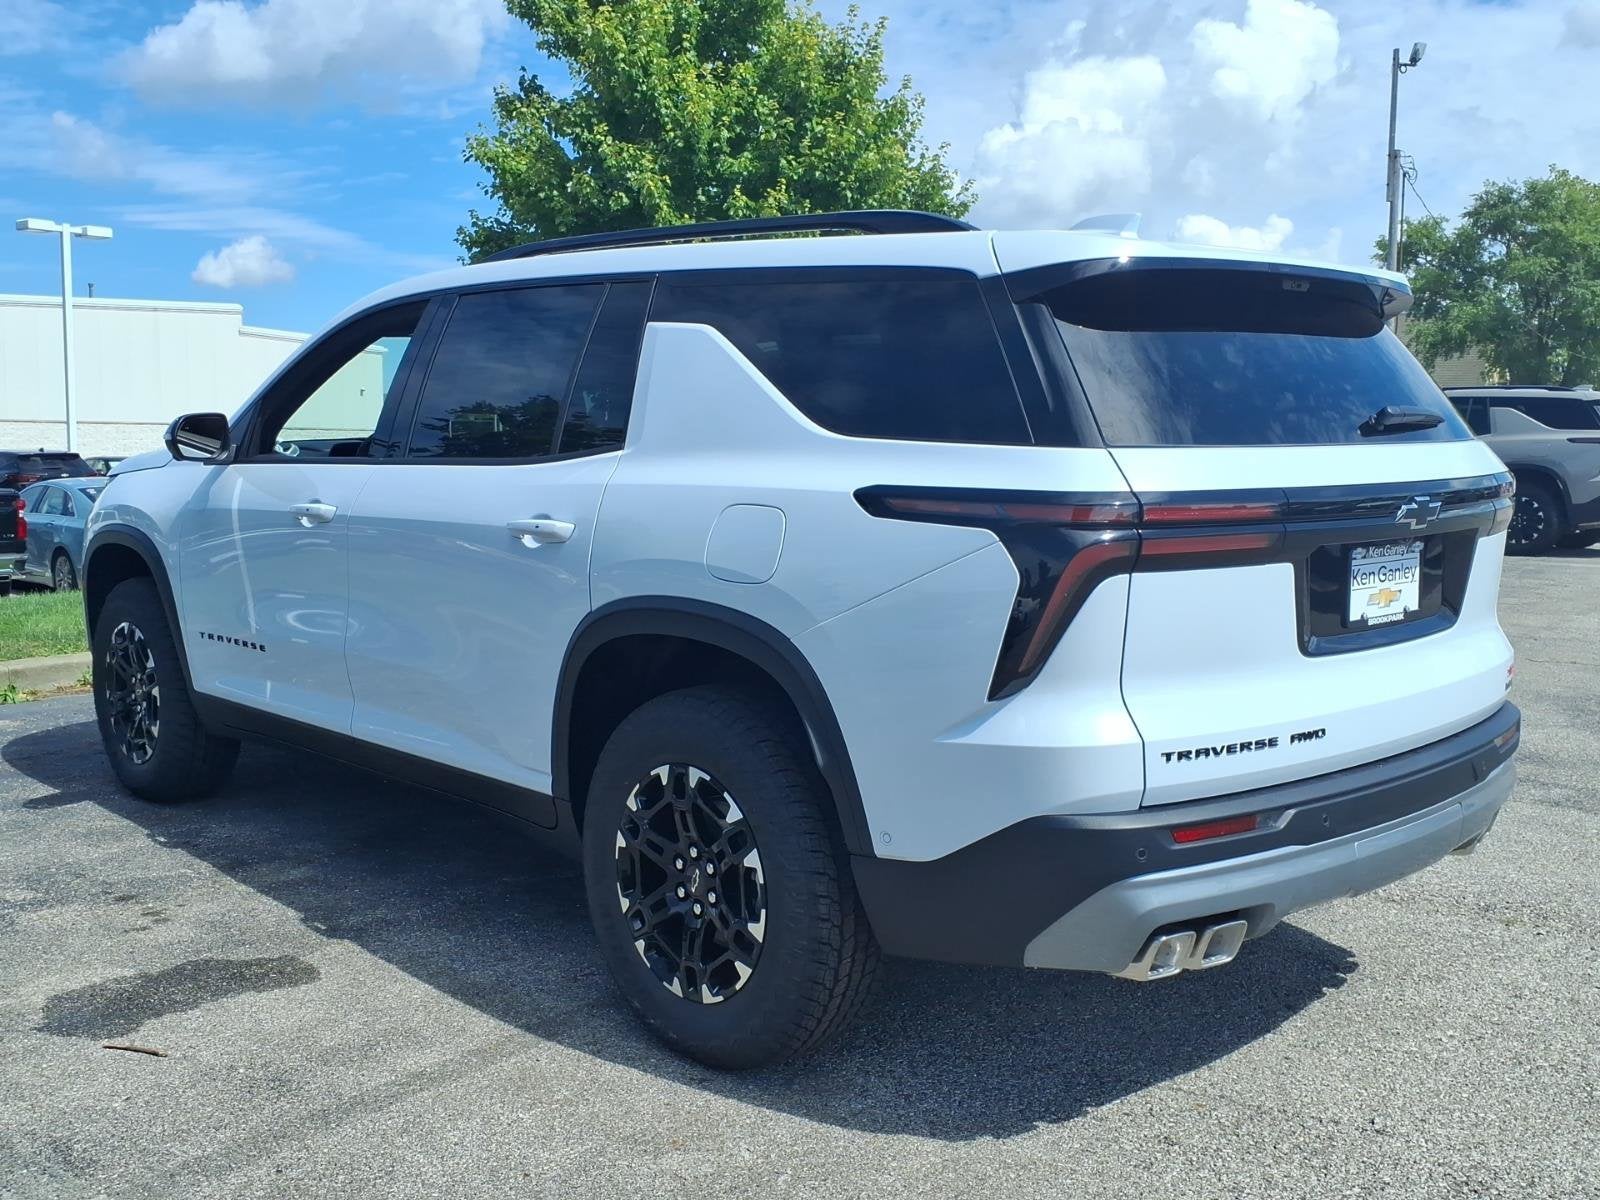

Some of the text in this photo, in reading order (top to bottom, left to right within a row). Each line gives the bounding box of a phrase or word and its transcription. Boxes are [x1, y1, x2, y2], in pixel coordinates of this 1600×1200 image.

[1369, 544, 1408, 557] Ken Ganley
[1352, 563, 1417, 587] Ken Ganley
[199, 631, 266, 653] TRAVERSE
[1161, 727, 1326, 764] TRAVERSE AWD
